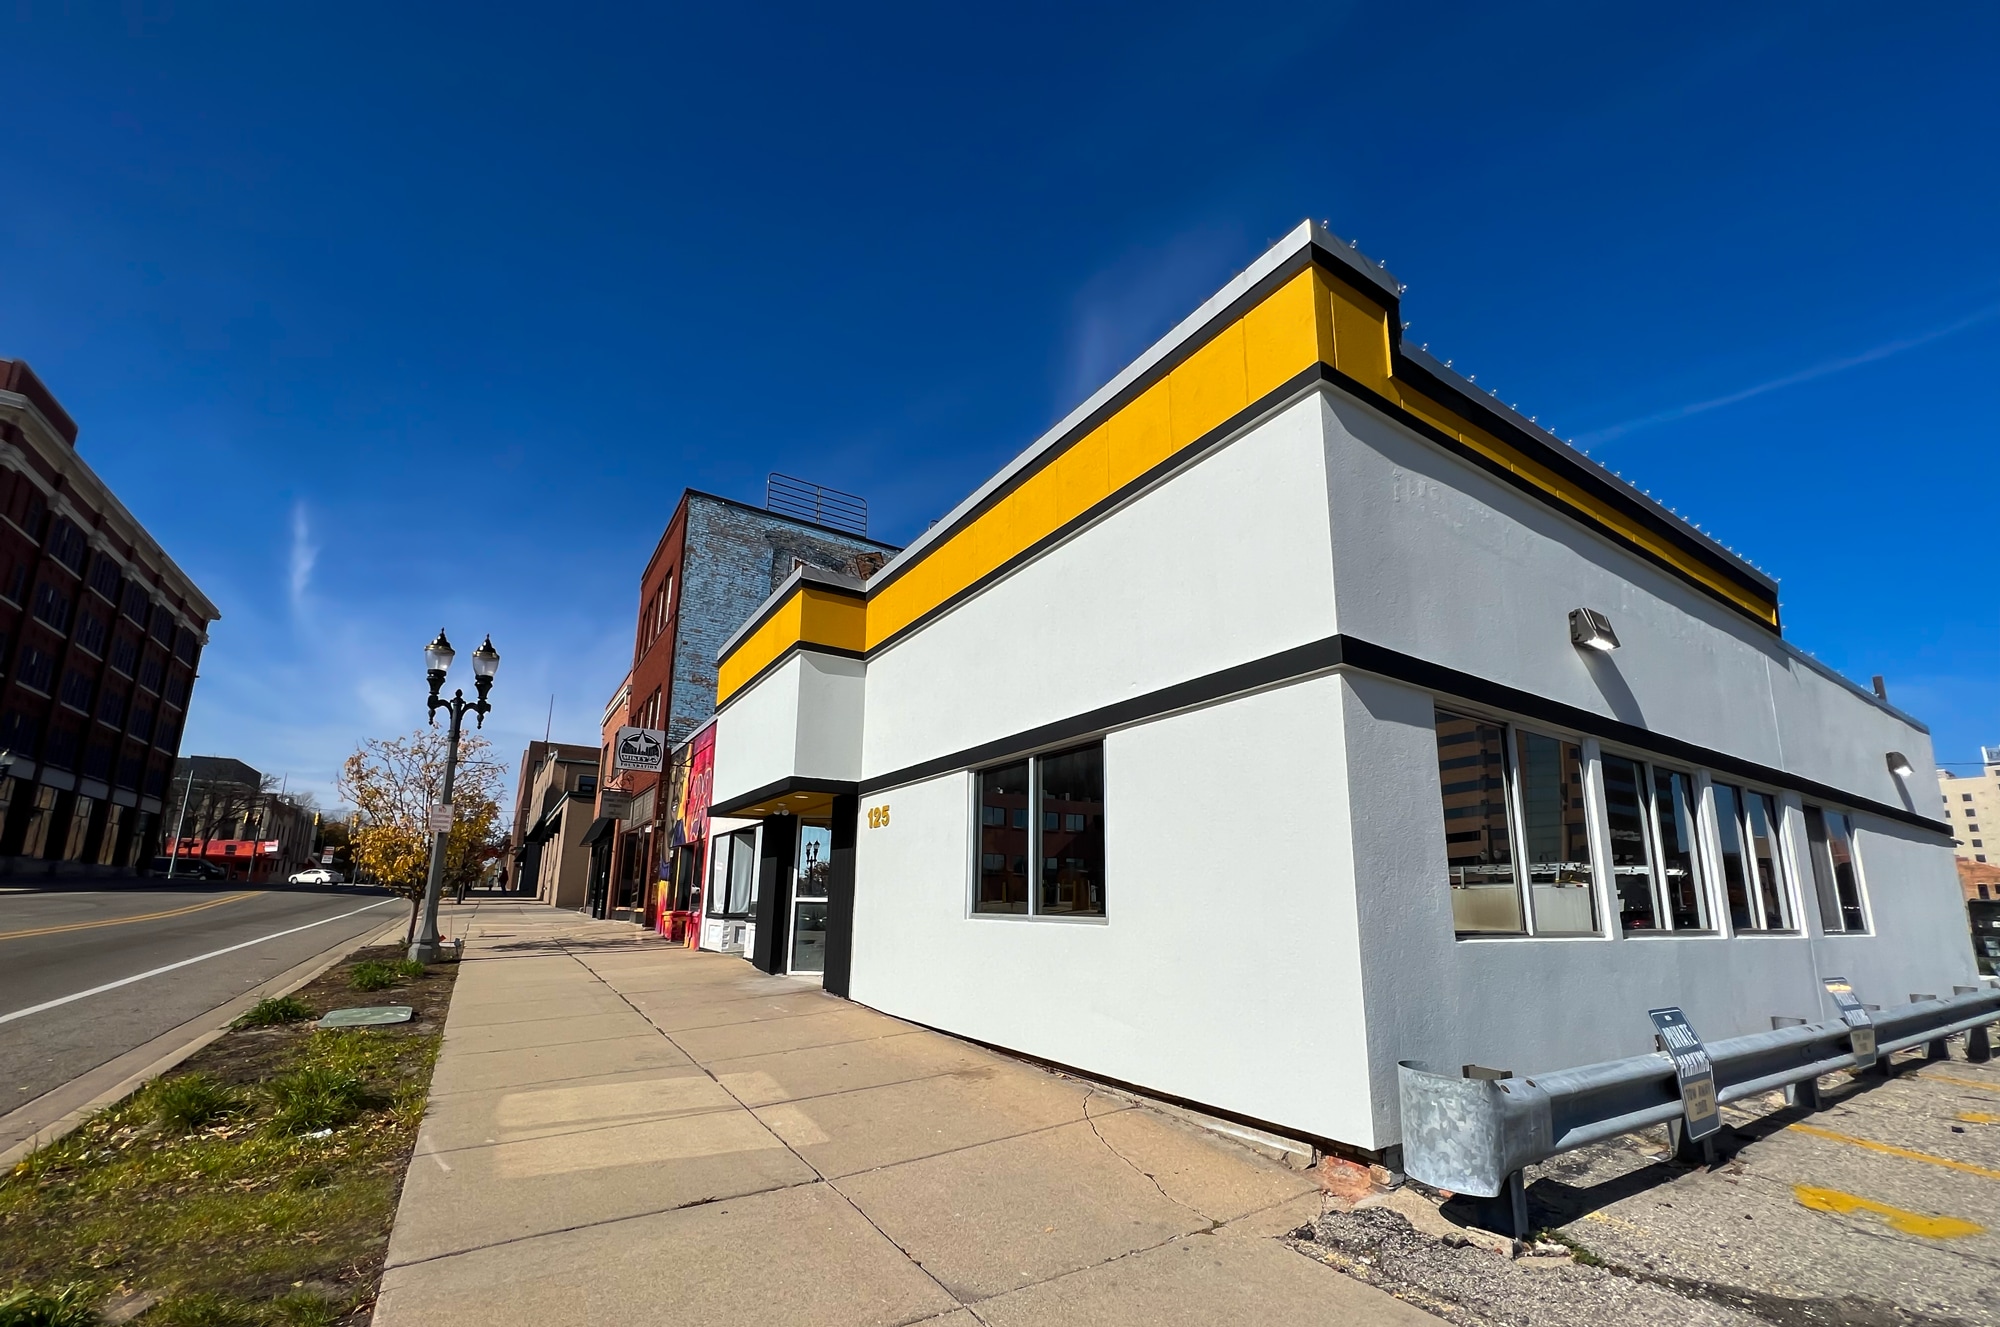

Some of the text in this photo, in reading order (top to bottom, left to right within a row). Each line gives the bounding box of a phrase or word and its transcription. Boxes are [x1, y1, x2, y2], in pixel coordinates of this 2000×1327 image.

[620, 762, 658, 770] FOUNDATION
[867, 804, 890, 829] 125
[1661, 1023, 1699, 1050] PRIVATE
[1676, 1050, 1711, 1079] PARKING
